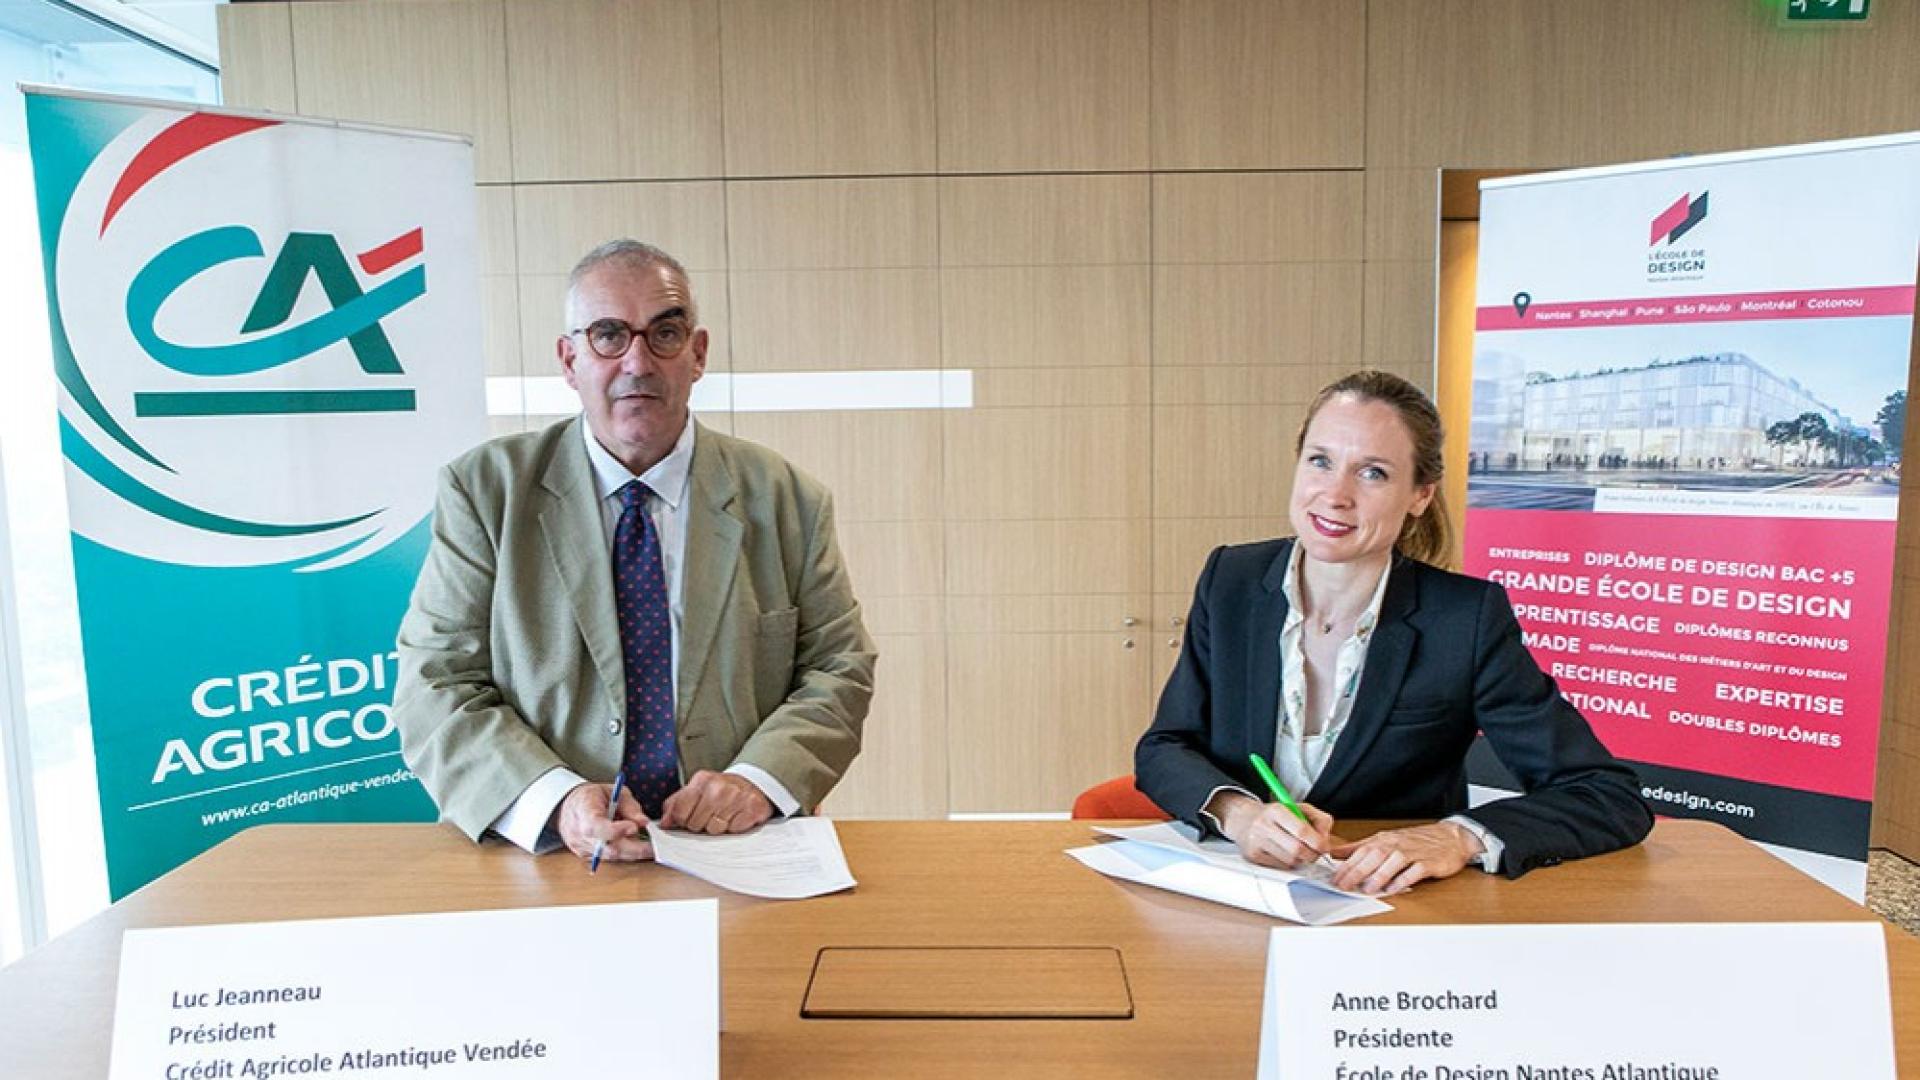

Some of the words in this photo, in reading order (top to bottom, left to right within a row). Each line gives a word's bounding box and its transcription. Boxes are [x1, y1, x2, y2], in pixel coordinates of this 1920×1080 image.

[1648, 260, 1705, 273] DESIGN
[126, 225, 426, 376] CA
[1535, 311, 1572, 320] Nantes
[1579, 308, 1628, 319] Shanghai
[1635, 306, 1664, 316] Pune
[1674, 304, 1696, 314] São
[1698, 302, 1732, 313] Paulo
[1741, 300, 1796, 311] Montréal
[1807, 298, 1863, 309] Cotonou
[1489, 548, 1570, 562] ENTREPRISES
[1584, 551, 1666, 571] DIPLÔME
[1671, 558, 1697, 573] DE
[1702, 560, 1775, 579] DESIGN
[1781, 566, 1825, 583] BAC
[1830, 570, 1855, 585] +5
[1488, 570, 1590, 595] GRANDE
[1597, 573, 1684, 604] ÉCOLE
[1691, 586, 1729, 608] DE
[1737, 590, 1851, 619] DESIGN
[1513, 604, 1660, 633] PRENTISSAGE
[1521, 632, 1581, 653] MADE
[1674, 622, 1752, 641] DIPLÔMES
[1755, 631, 1849, 651] RECONNUS
[1588, 643, 1628, 655] DIPLÔME
[1631, 649, 1677, 661] NATIONAL
[1679, 654, 1698, 663] DES
[1700, 655, 1741, 668] MÉTIERS
[1743, 662, 1772, 672] D'ART
[1774, 666, 1787, 674] ET
[1788, 667, 1805, 676] DU
[1806, 668, 1847, 680] DESIGN
[1552, 662, 1677, 692] RECHERCHE
[1716, 683, 1844, 715] EXPERTISE
[1668, 710, 1745, 733] DOUBLES
[1749, 722, 1841, 747] DIPLÔMES
[152, 703, 395, 784] AGRICO
[1641, 786, 1755, 818] edesign.com
[172, 990, 209, 1009] Luc
[215, 986, 321, 1007] Jeanneau
[1332, 992, 1390, 1011] Anne
[1397, 990, 1497, 1011] Brochard
[169, 1022, 277, 1045] Président
[1333, 1028, 1454, 1048] Présidente
[166, 1059, 234, 1080] Crédit
[240, 1053, 333, 1080] Agricole
[338, 1047, 457, 1070] Atlantique
[463, 1038, 547, 1061] Vendée
[1335, 1061, 1394, 1080] École
[1400, 1065, 1428, 1080] de
[1435, 1064, 1509, 1080] Design
[1516, 1064, 1594, 1080] Nantes
[1602, 1062, 1719, 1080] Atlantique
